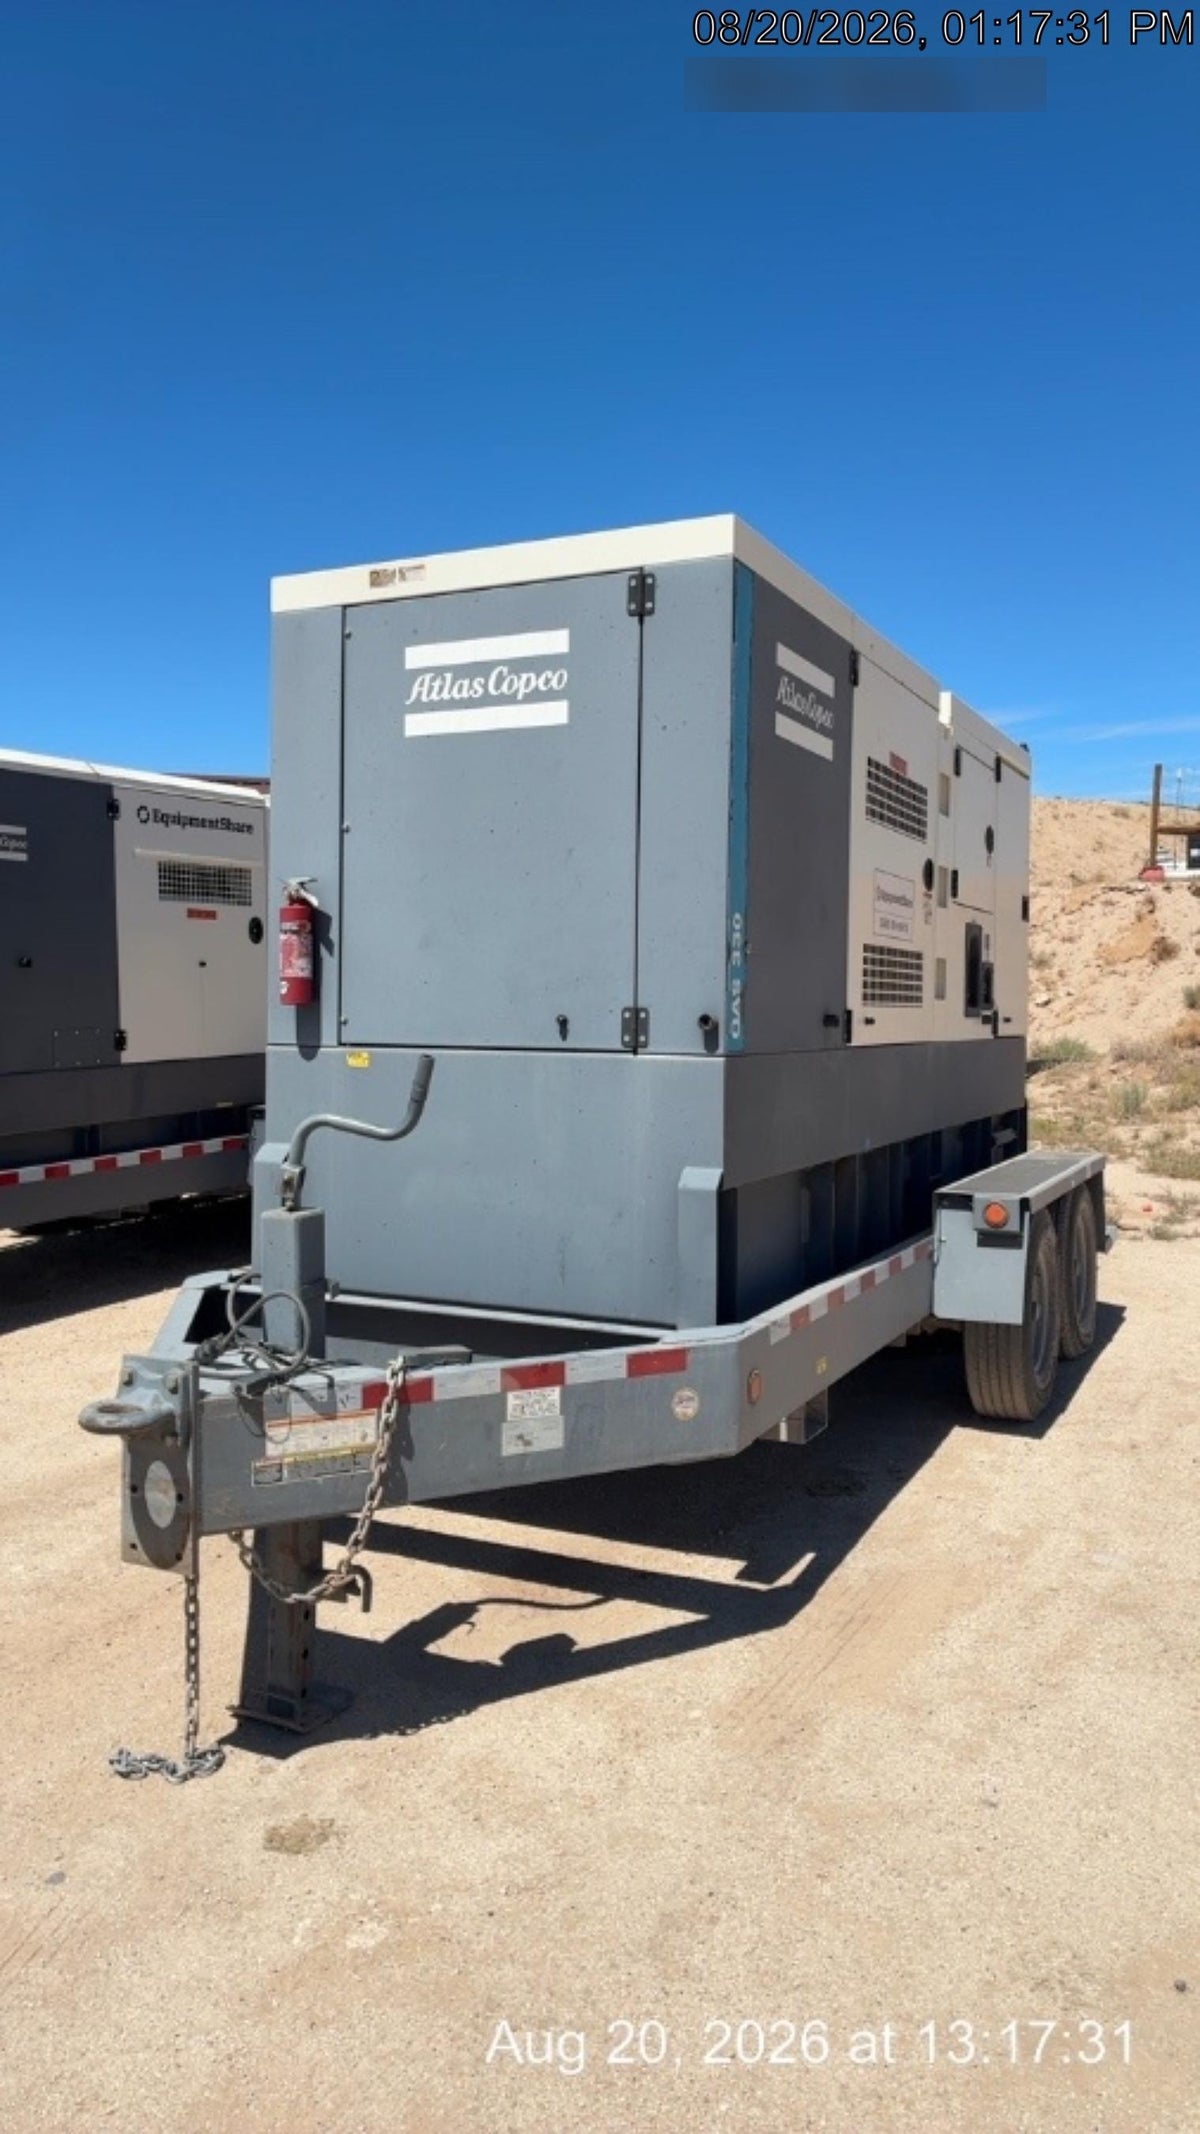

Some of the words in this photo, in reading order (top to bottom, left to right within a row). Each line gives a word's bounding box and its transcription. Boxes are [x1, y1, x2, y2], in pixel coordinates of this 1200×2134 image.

[405, 672, 485, 705] Atlas
[487, 665, 568, 700] Copco
[776, 676, 806, 716] Atlas
[806, 691, 834, 731] Copco
[153, 807, 254, 834] EquipmentShare
